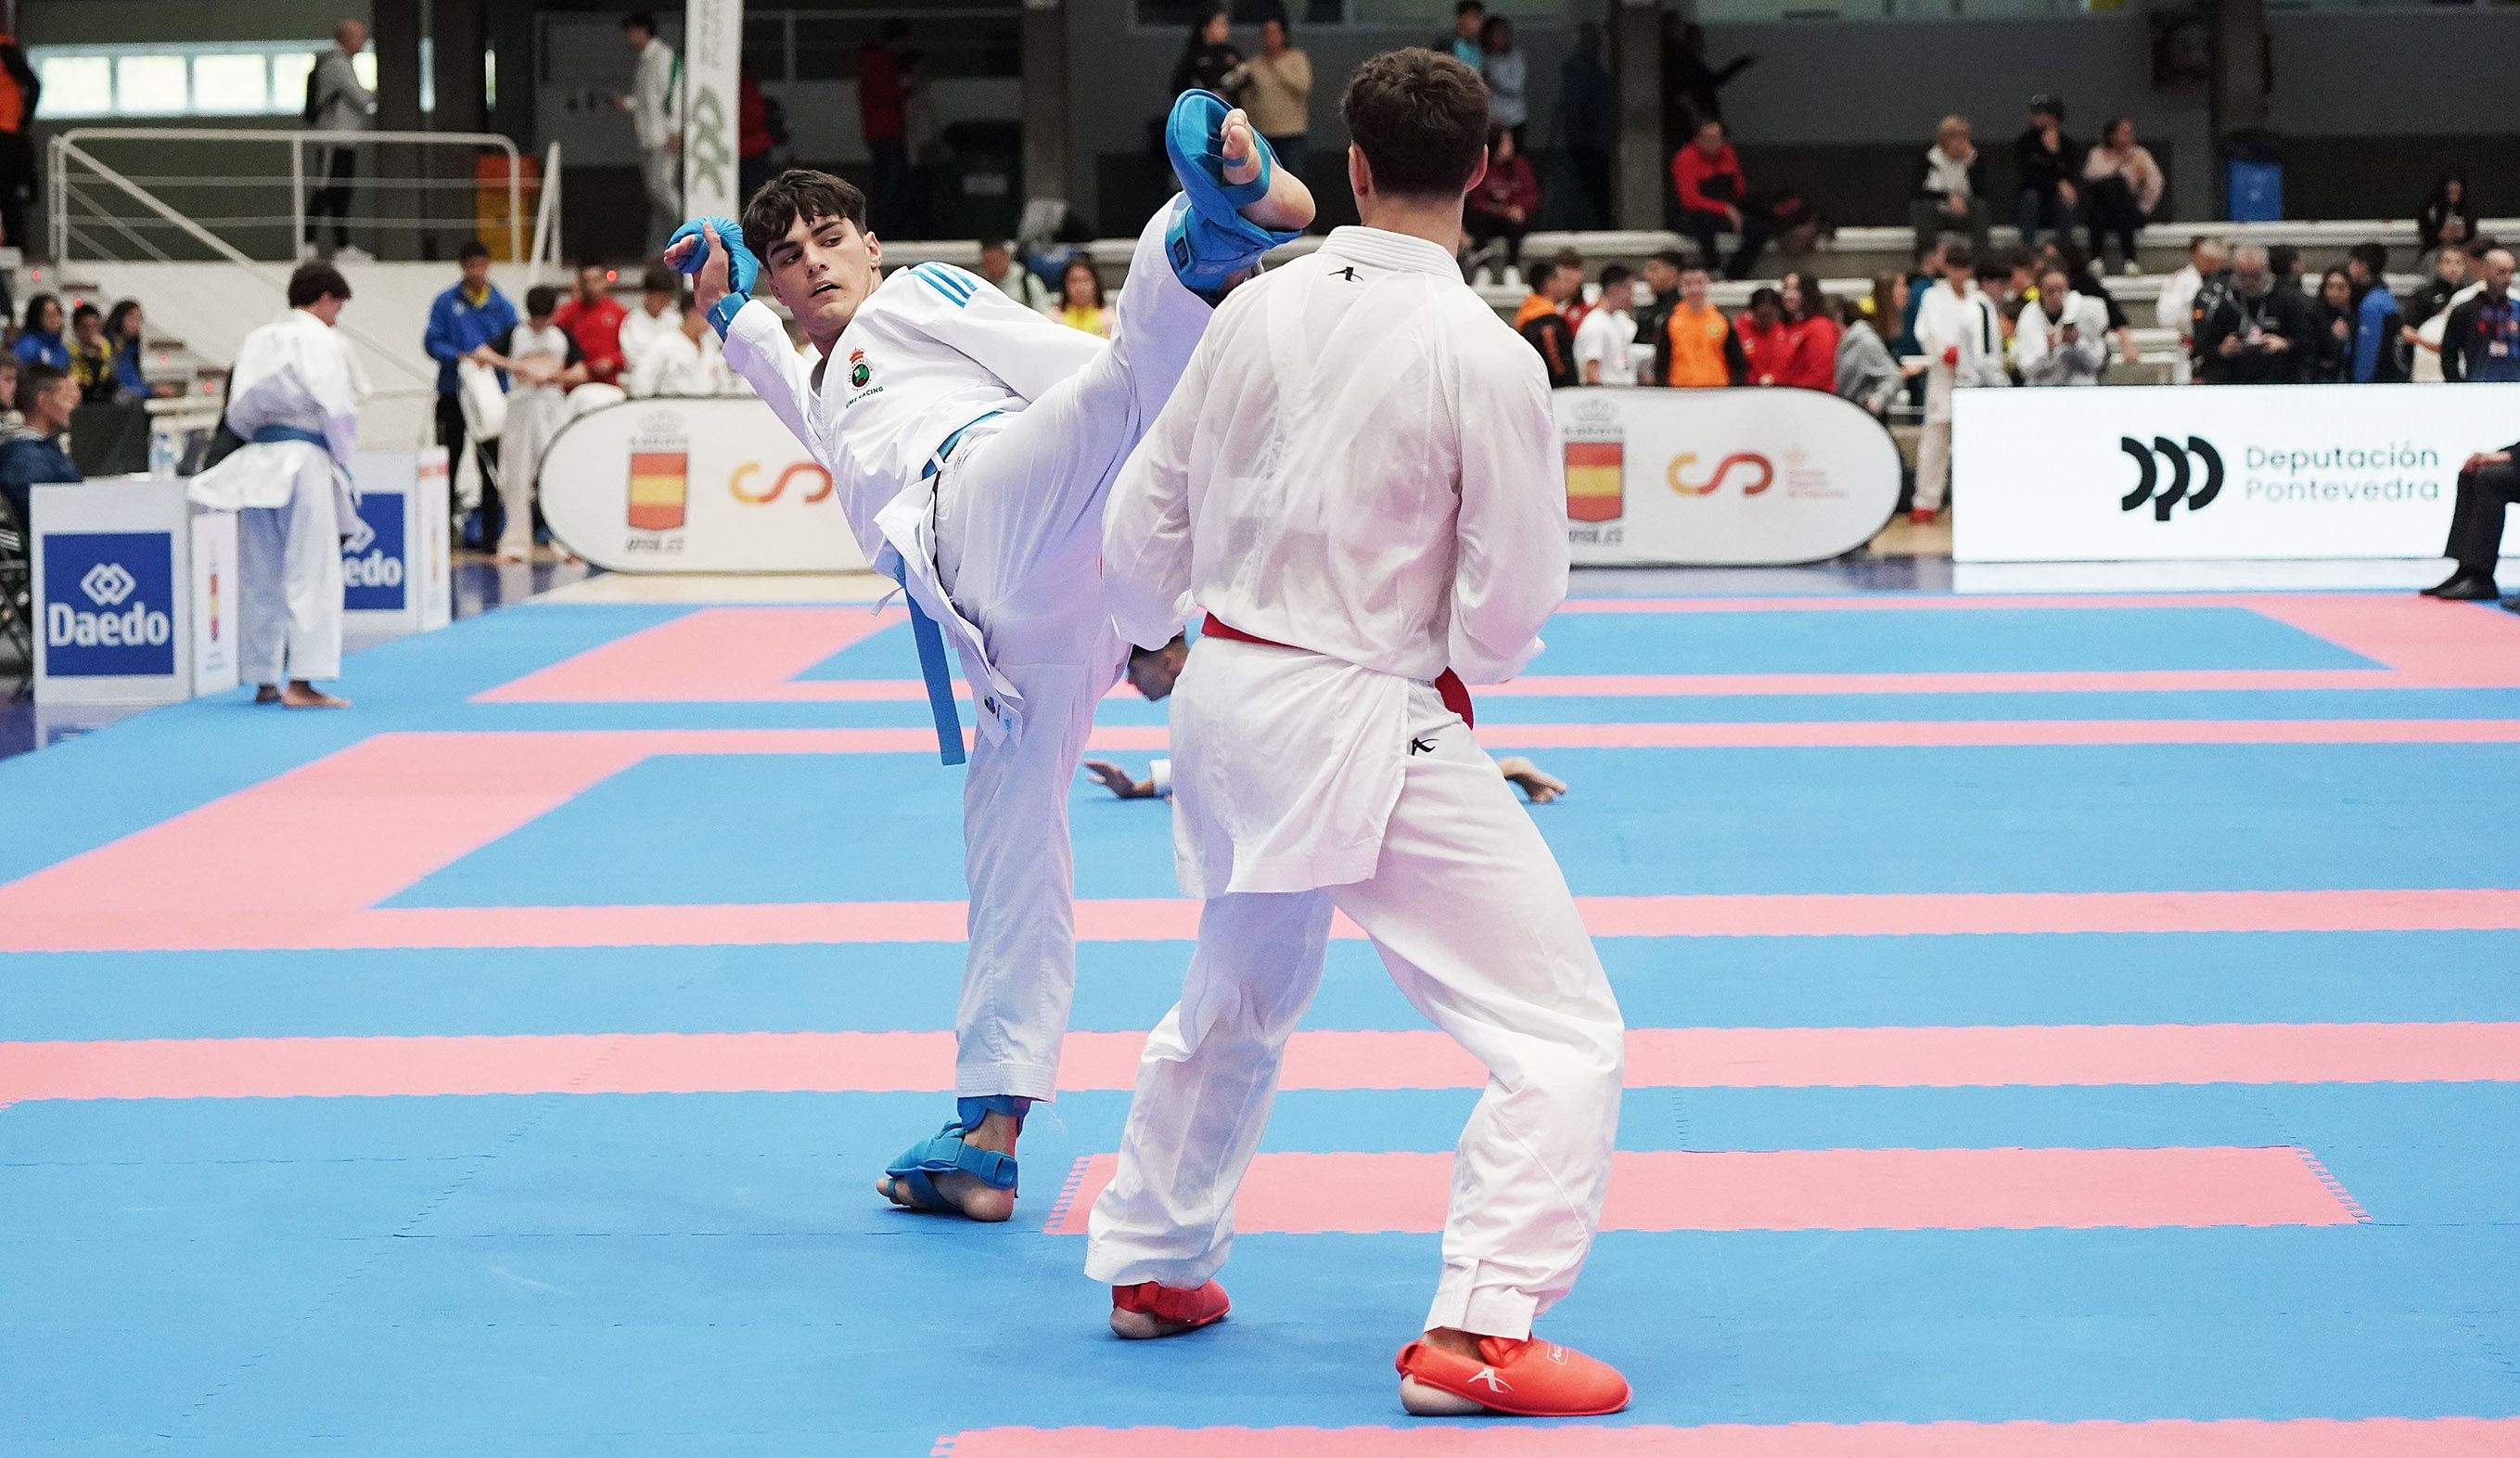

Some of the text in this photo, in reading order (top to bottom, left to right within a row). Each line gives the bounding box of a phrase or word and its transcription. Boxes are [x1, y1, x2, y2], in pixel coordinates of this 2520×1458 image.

[2246, 441, 2439, 475] Deputación
[2246, 477, 2439, 502] Pontevedra
[344, 548, 403, 586] edo
[47, 600, 170, 647] Daedo
